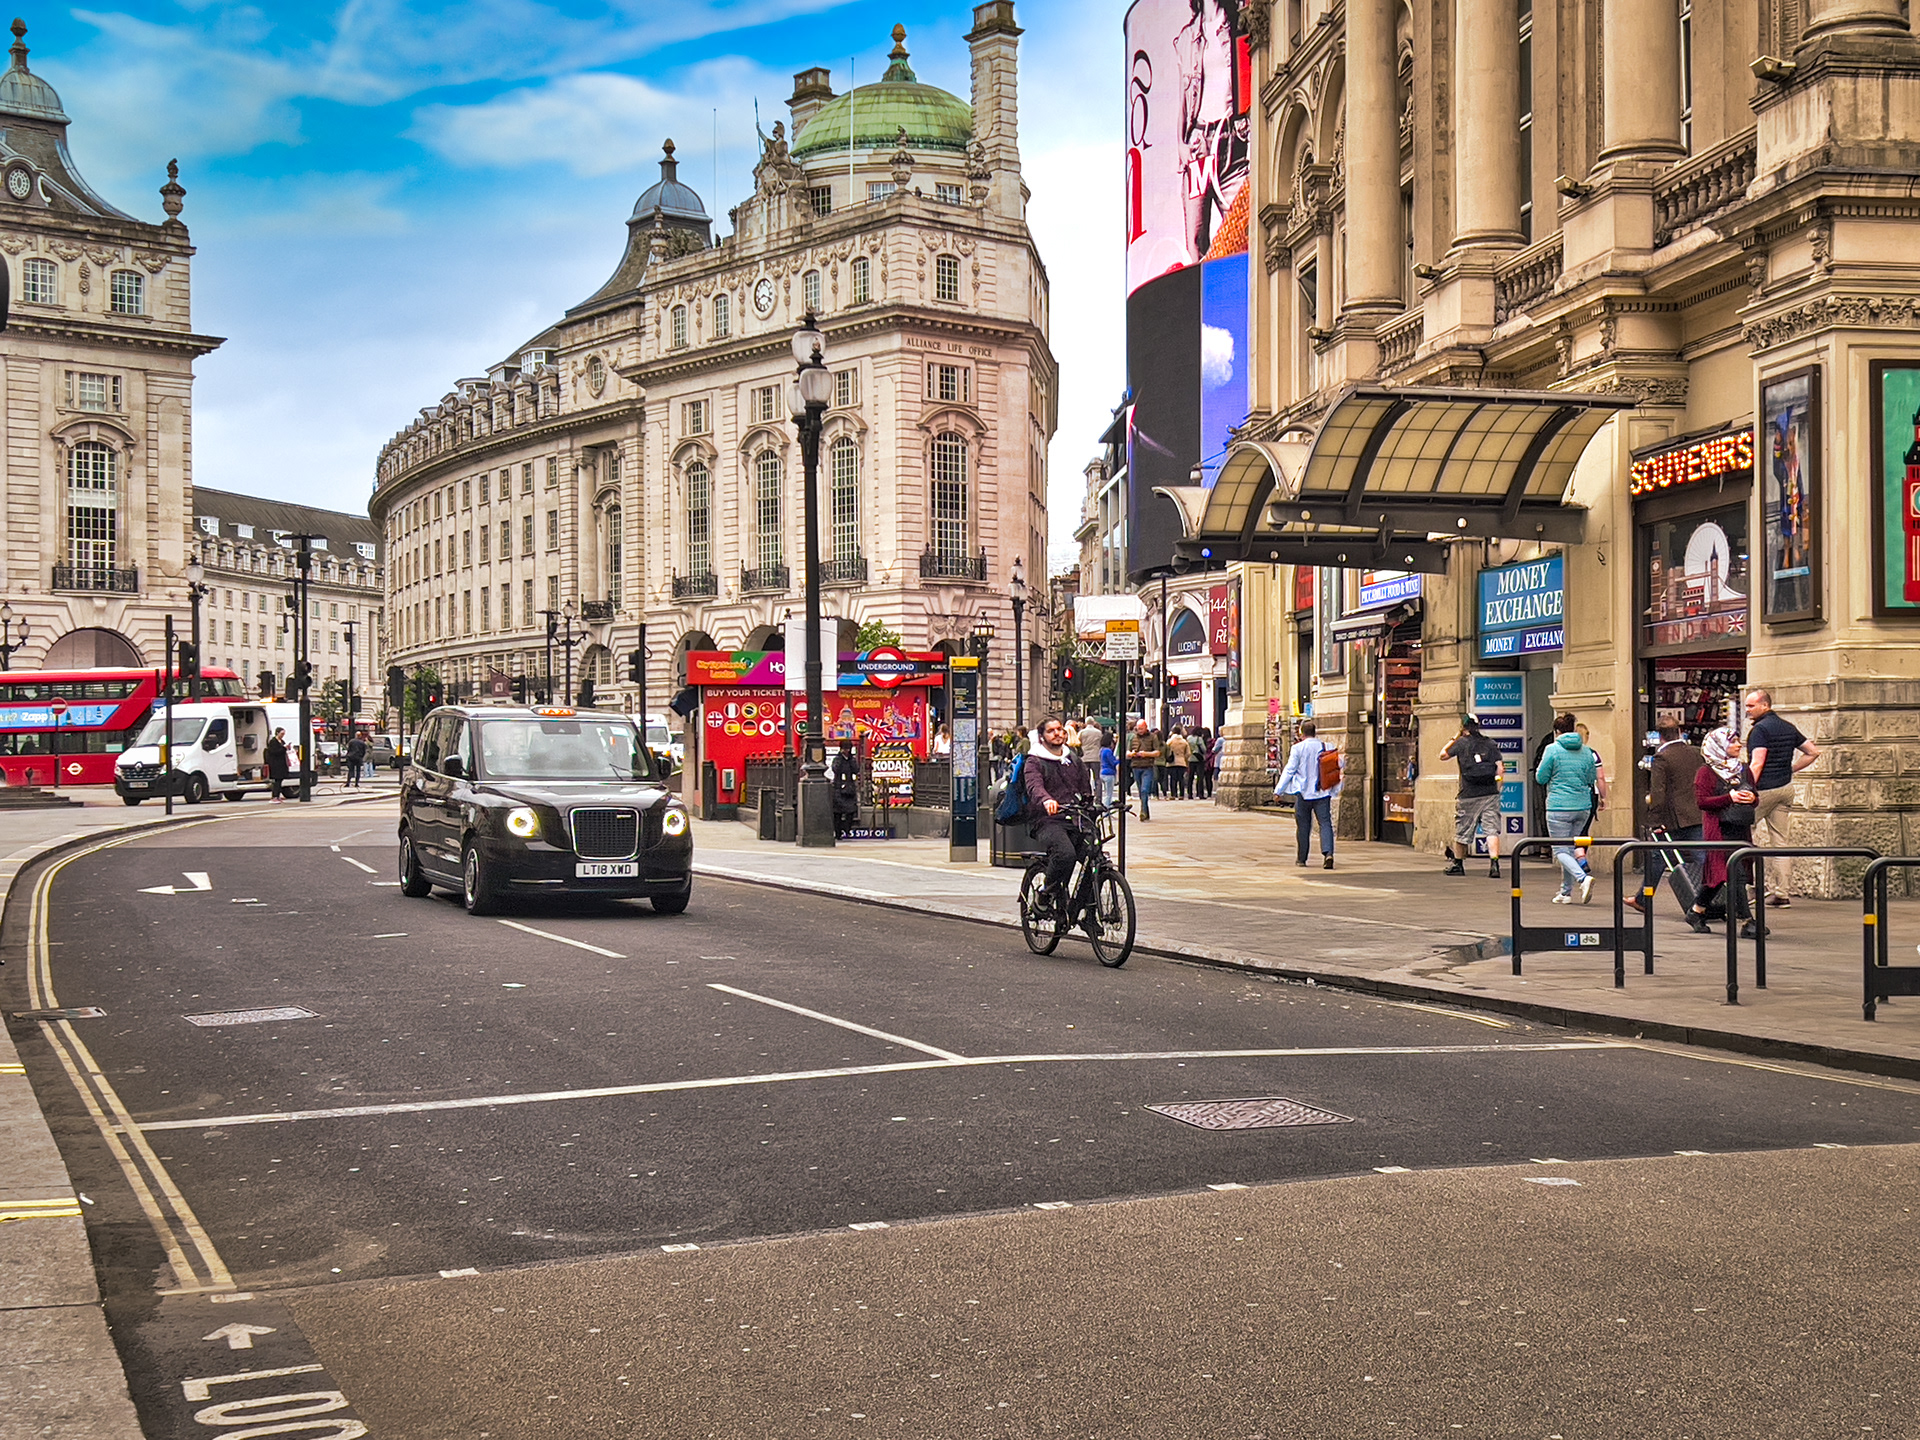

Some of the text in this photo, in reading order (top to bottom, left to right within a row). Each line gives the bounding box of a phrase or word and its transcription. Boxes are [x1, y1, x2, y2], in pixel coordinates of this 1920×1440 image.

[906, 337, 993, 357] ALLIANCE LIFE OFFICE
[1630, 431, 1753, 495] SOUVENIRS
[1496, 562, 1550, 595] MONEY
[1485, 590, 1564, 625] EXCHANGE
[1485, 636, 1515, 653] MONEY
[857, 663, 915, 671] UNDERGROUND
[706, 689, 725, 697] BUY
[726, 689, 751, 697] YOUR
[540, 708, 574, 716] TAXI
[1168, 705, 1183, 718] by an
[21, 712, 48, 723] Zapp
[1481, 718, 1515, 726] CAMBIO
[873, 760, 911, 771] KODAK
[583, 864, 632, 875] LT18 XWD
[1567, 934, 1577, 945] P
